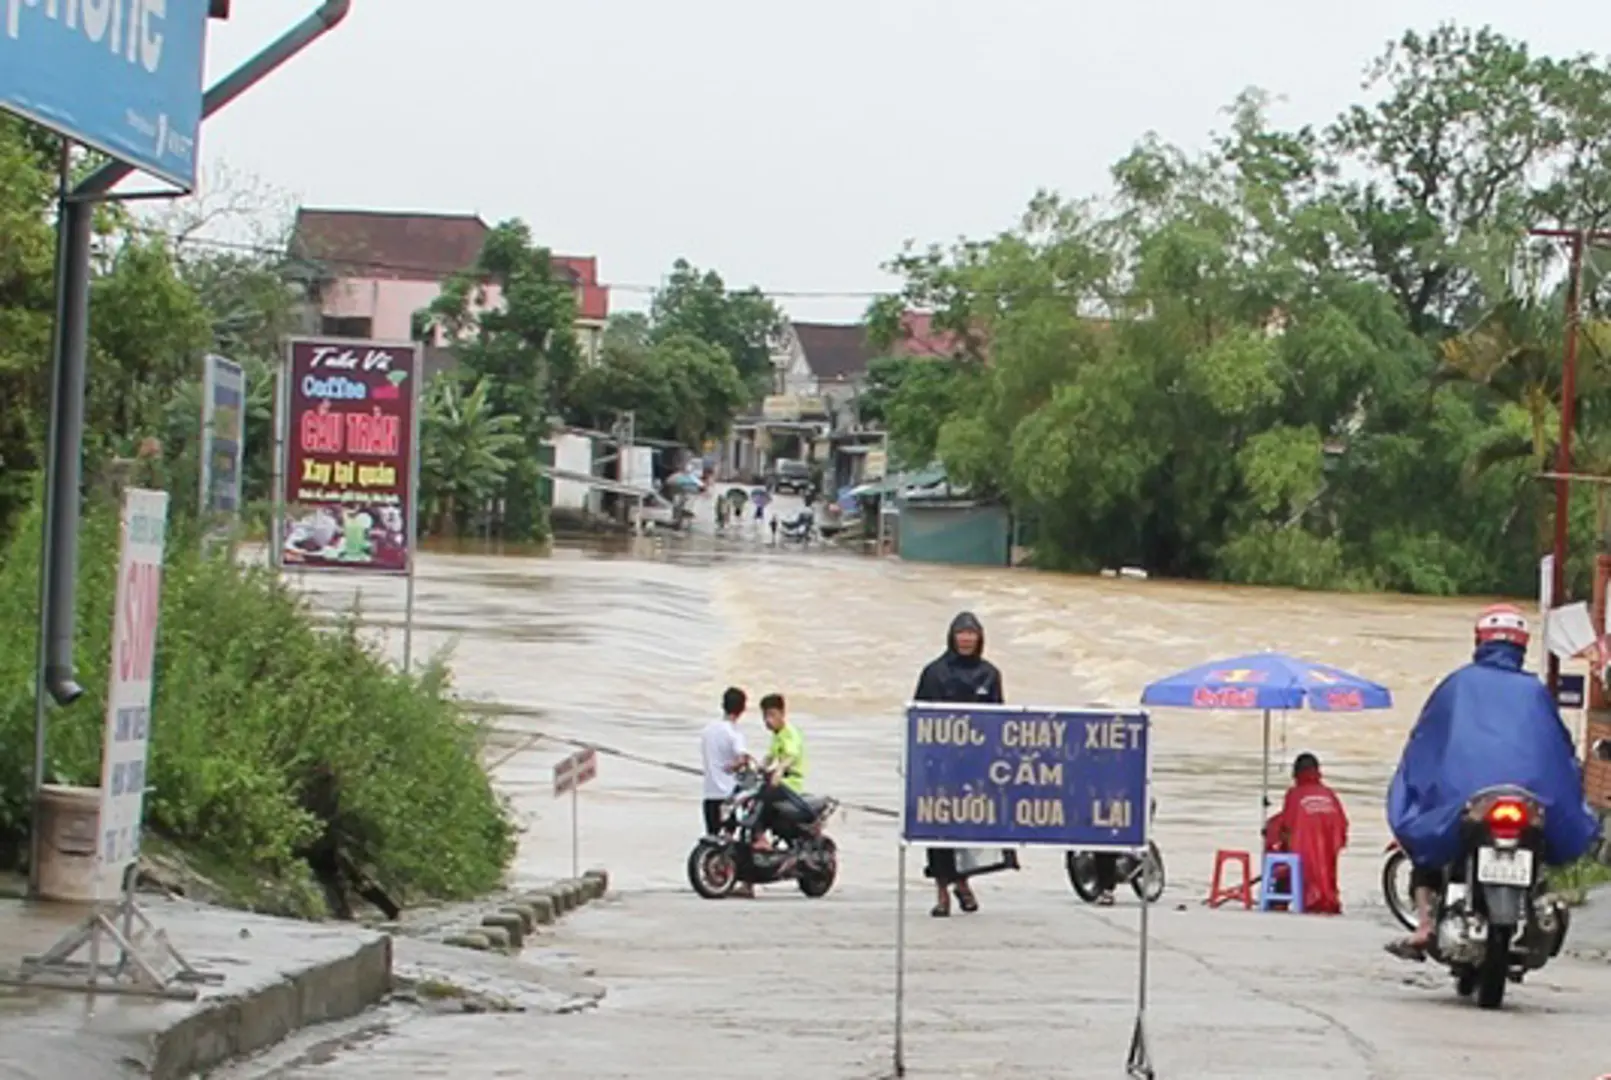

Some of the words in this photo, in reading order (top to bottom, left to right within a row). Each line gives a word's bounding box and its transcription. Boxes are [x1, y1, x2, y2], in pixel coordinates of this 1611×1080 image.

[301, 373, 367, 400] Coffee
[302, 458, 331, 486] Xay
[334, 460, 355, 490] tại
[989, 750, 1063, 786] CẤM
[916, 783, 996, 825] NGƯỜI
[1016, 797, 1065, 828] QUA
[1092, 799, 1131, 836] LẠI
